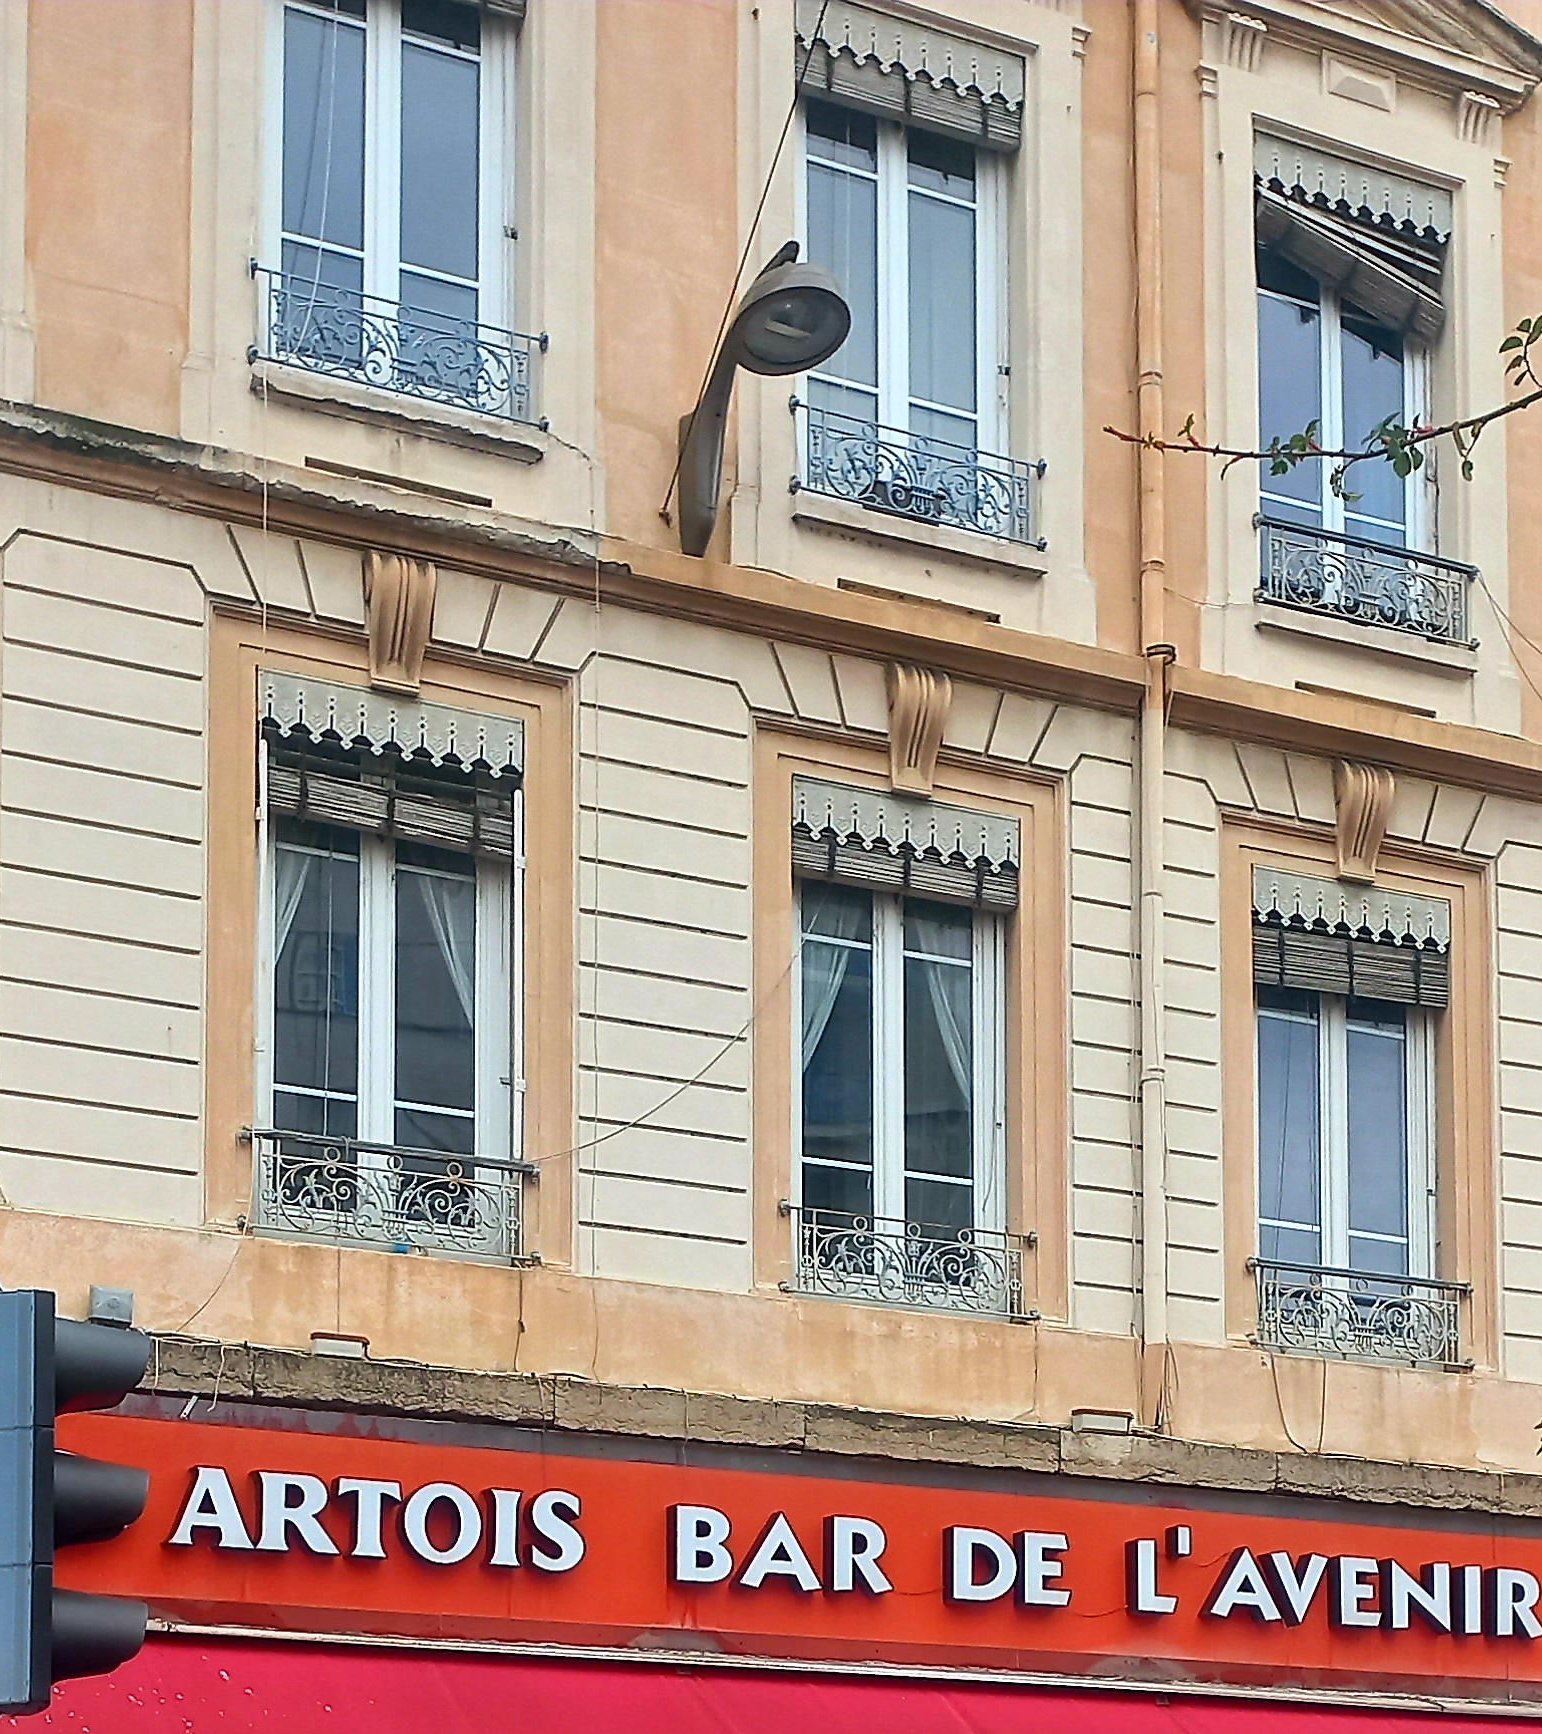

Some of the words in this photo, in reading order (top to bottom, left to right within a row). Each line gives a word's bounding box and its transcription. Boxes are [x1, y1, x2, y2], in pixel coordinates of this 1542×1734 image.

[167, 1466, 586, 1573] ARTOIS
[675, 1505, 893, 1594] BAR
[952, 1526, 1071, 1606] DE
